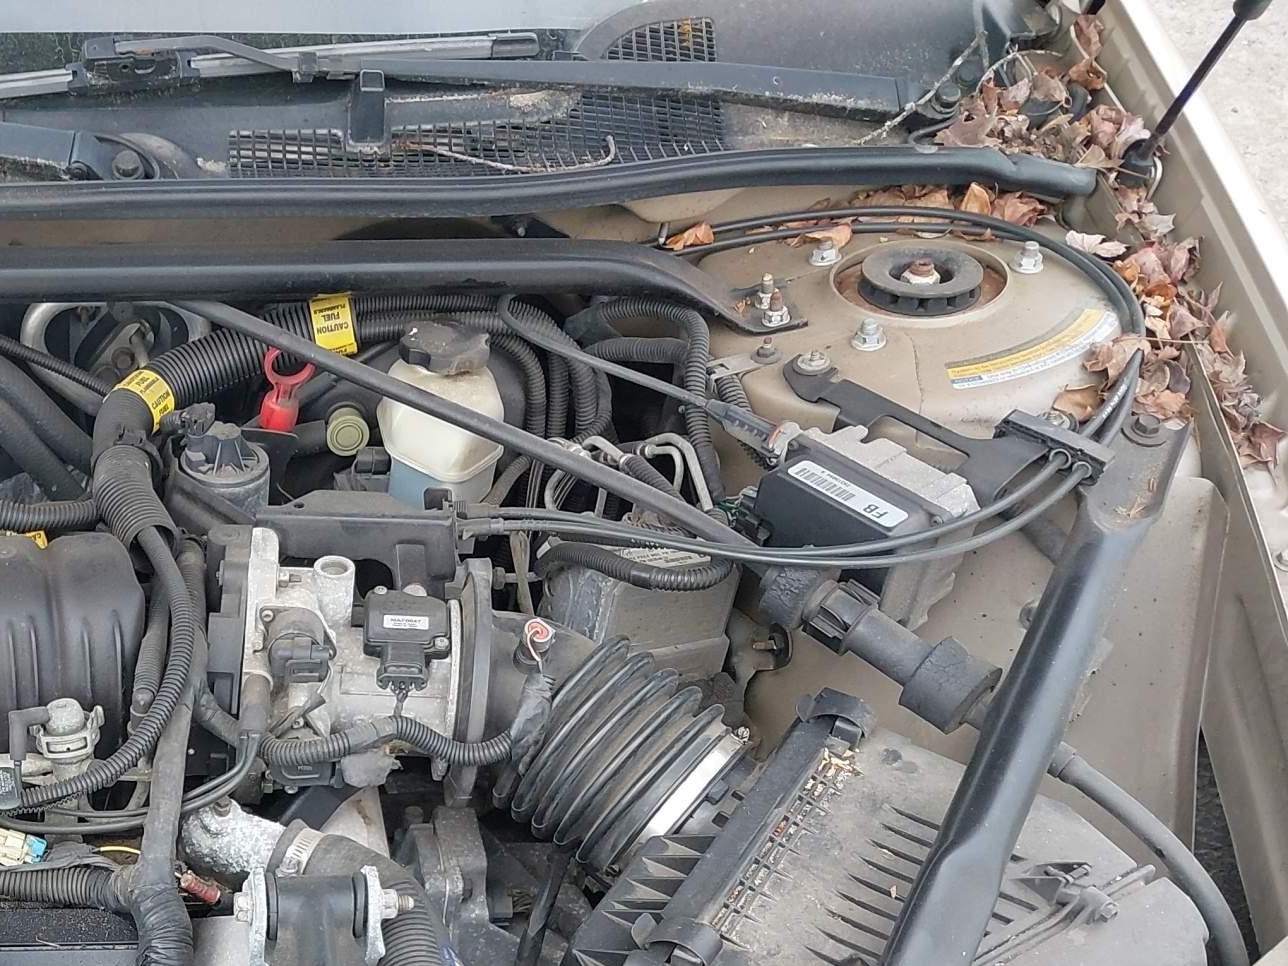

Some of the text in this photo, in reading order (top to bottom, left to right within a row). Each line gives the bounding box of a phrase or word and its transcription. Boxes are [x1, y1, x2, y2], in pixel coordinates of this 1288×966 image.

[321, 312, 340, 321] FUEL
[317, 322, 349, 335] CAUTION
[863, 504, 889, 518] FB
